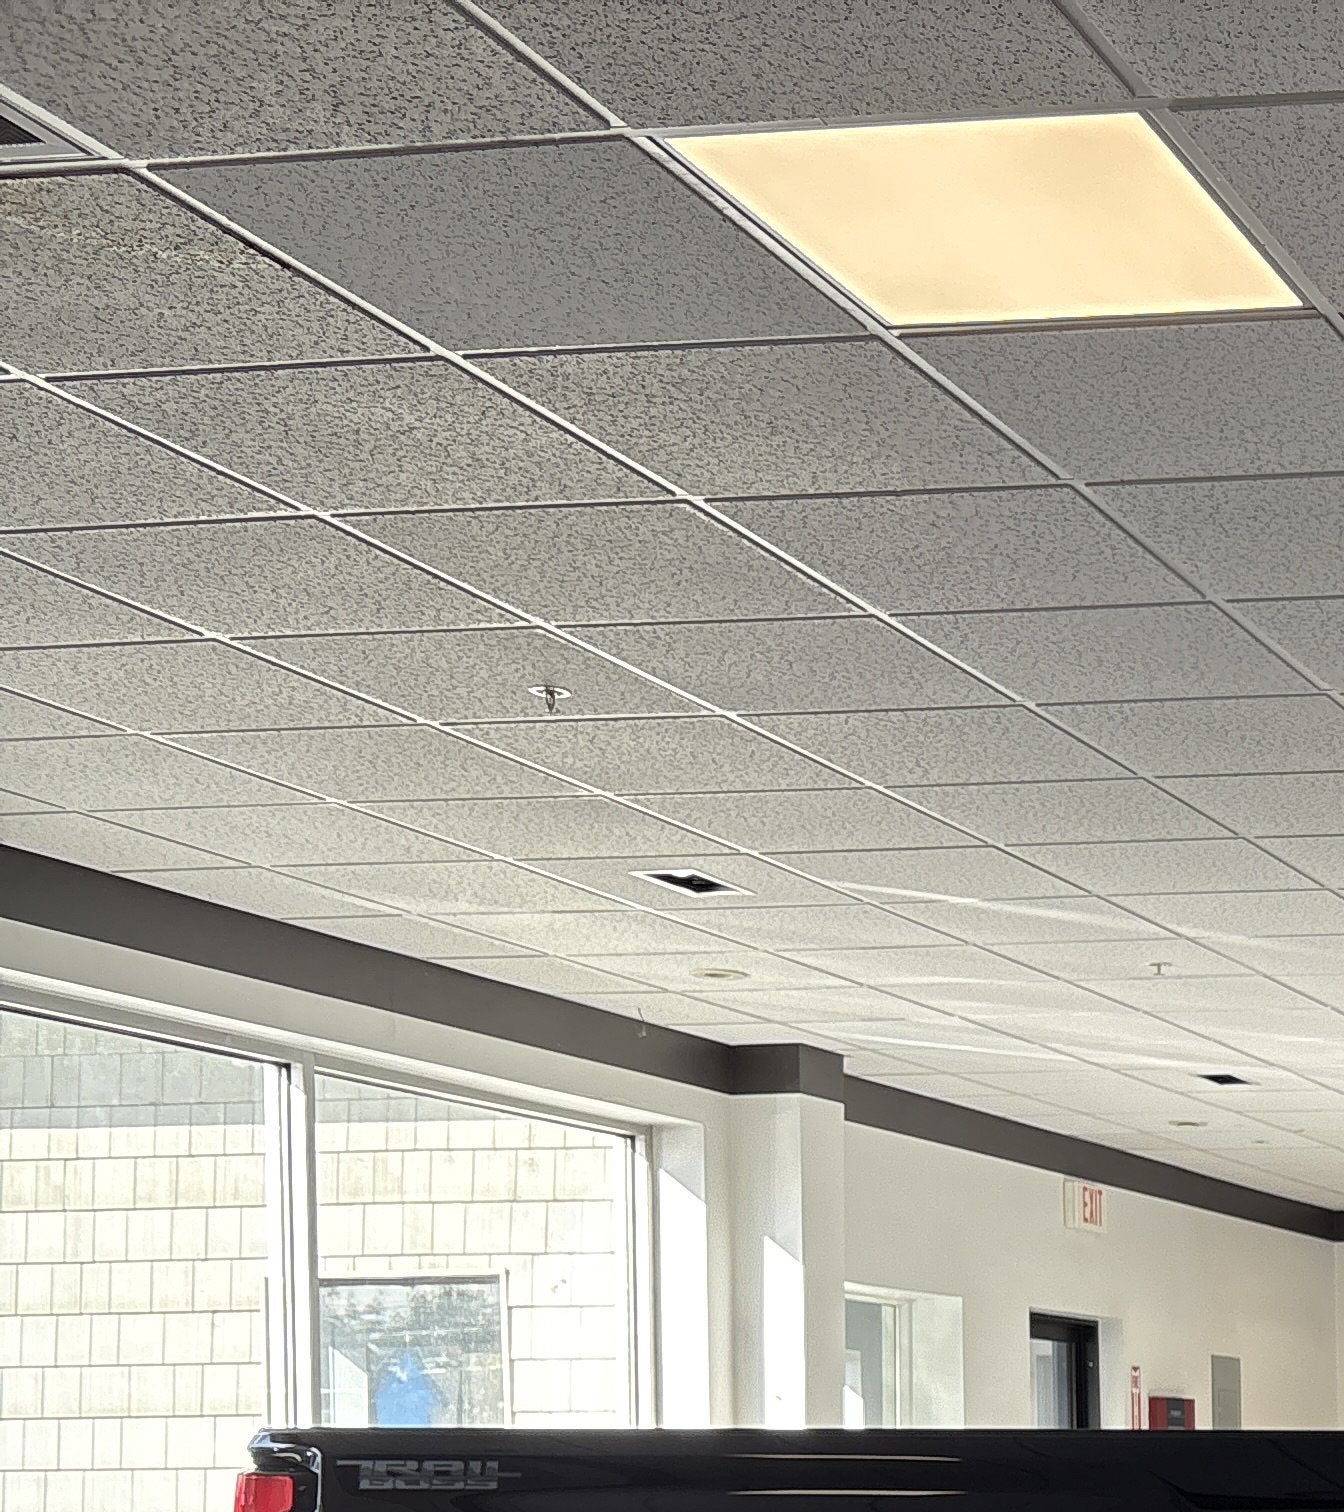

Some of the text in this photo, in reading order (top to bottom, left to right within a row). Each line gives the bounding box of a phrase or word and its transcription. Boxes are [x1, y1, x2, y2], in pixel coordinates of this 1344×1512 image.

[1082, 1186, 1102, 1226] EXIT
[336, 1459, 522, 1479] TRAIL
[359, 1476, 499, 1491] BOSS
